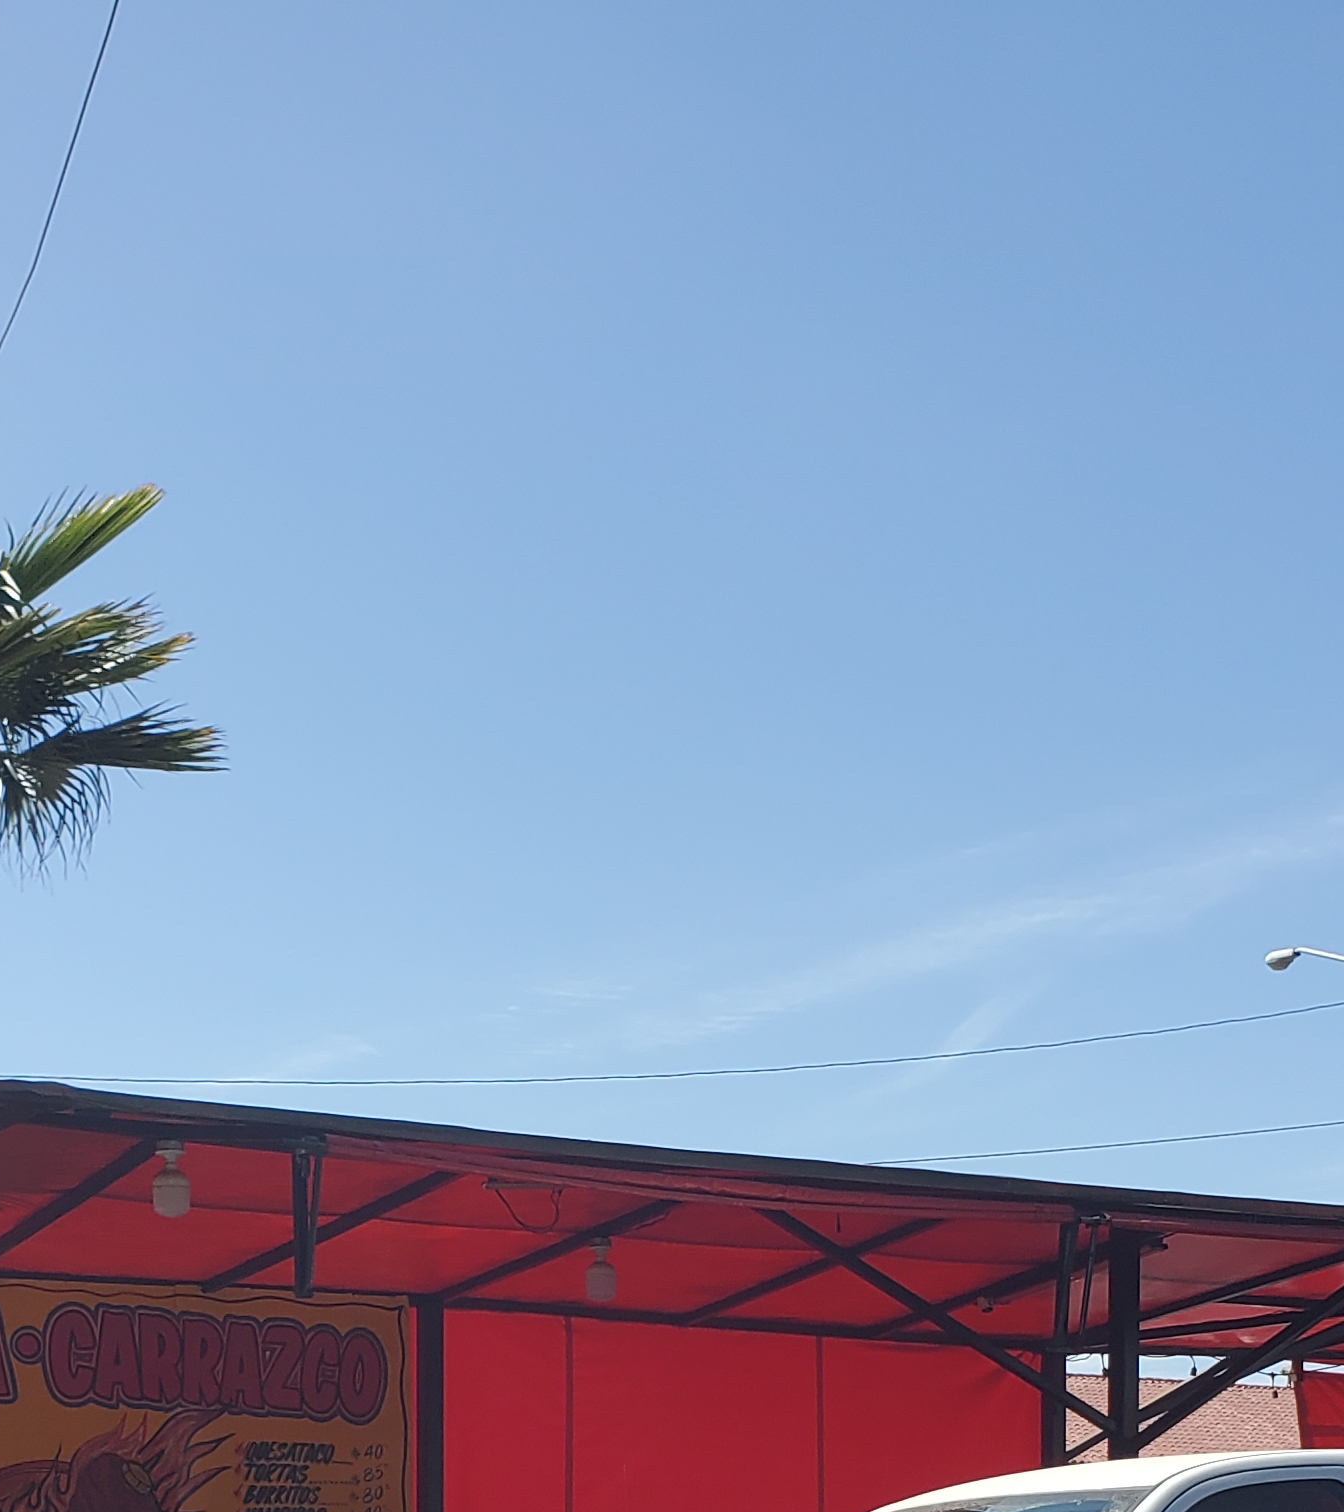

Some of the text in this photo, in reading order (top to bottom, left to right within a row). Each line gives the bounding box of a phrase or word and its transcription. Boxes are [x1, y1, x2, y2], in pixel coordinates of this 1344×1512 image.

[43, 1301, 391, 1426] CARRAZCO
[244, 1441, 335, 1464] QUESATACO
[242, 1463, 310, 1484] TORTAS
[242, 1485, 322, 1506] BURRITOS
